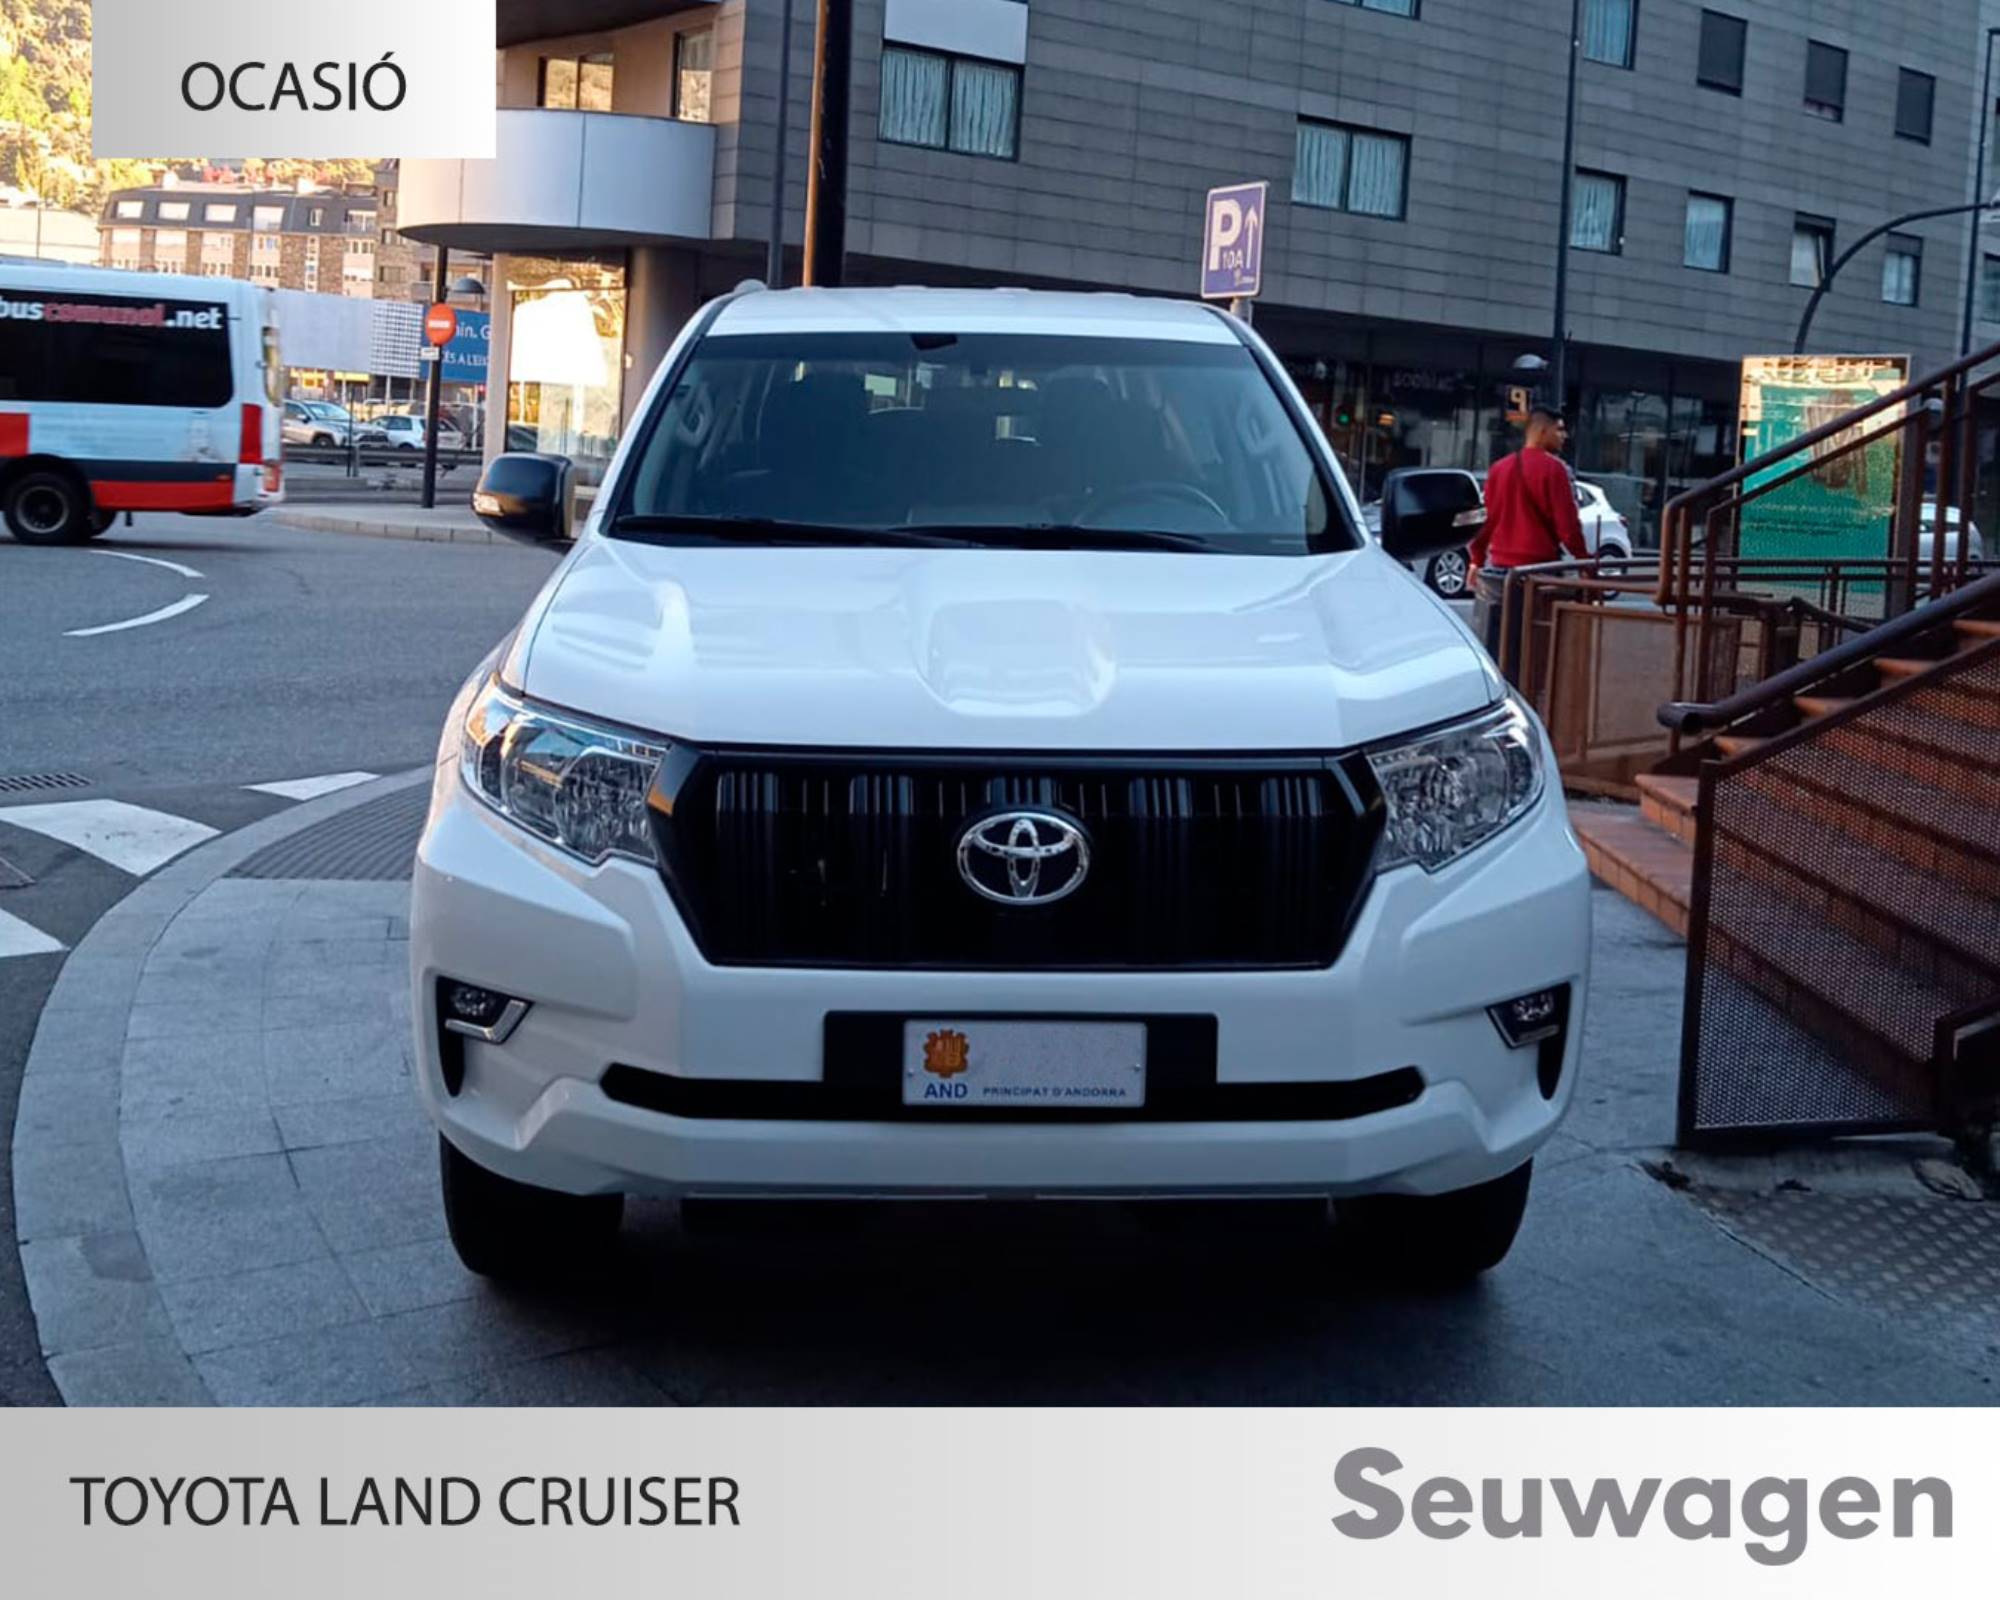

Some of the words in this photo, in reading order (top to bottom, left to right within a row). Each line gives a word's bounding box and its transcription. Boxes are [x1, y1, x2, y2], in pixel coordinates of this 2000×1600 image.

[1209, 199, 1242, 271] P
[923, 1083, 969, 1100] AND
[982, 1086, 1049, 1098] PRINCIPAT
[1052, 1086, 1127, 1099] D'ANDORRA
